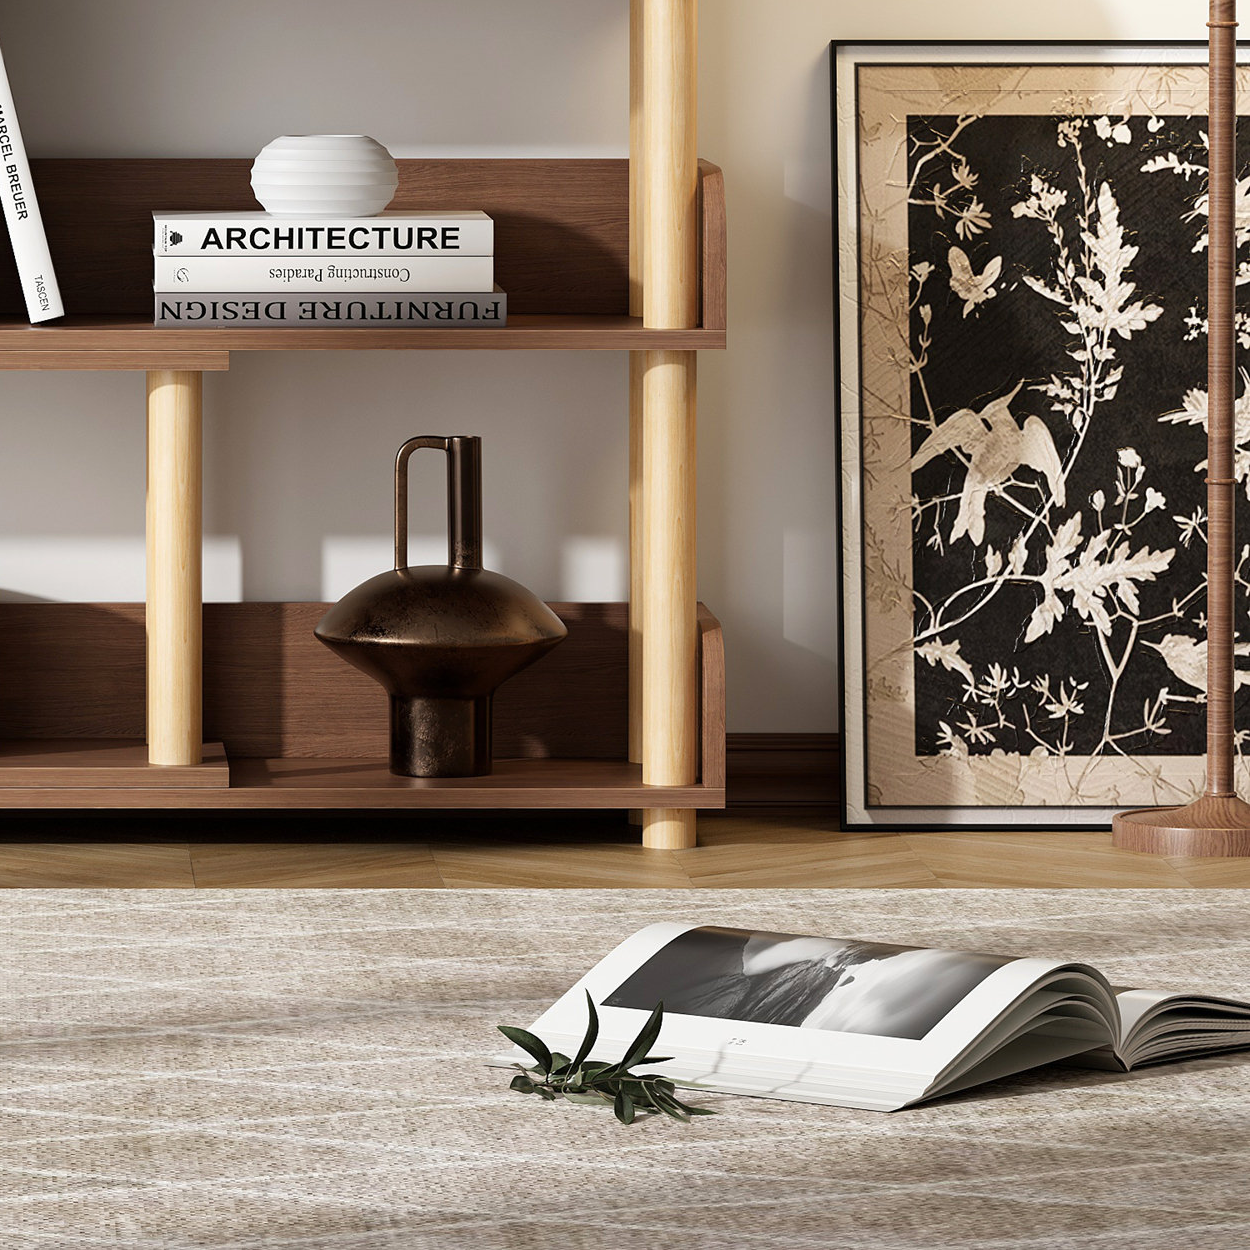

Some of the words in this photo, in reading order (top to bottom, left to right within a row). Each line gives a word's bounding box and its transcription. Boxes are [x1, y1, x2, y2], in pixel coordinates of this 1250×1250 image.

[6, 164, 28, 221] BREUER
[200, 226, 461, 250] ARCHITECTURE
[269, 267, 323, 282] Paradies
[327, 264, 410, 282] Constructing
[34, 274, 49, 312] TASCEN
[159, 300, 287, 320] DESIGN
[298, 300, 501, 320] FURNITURE
